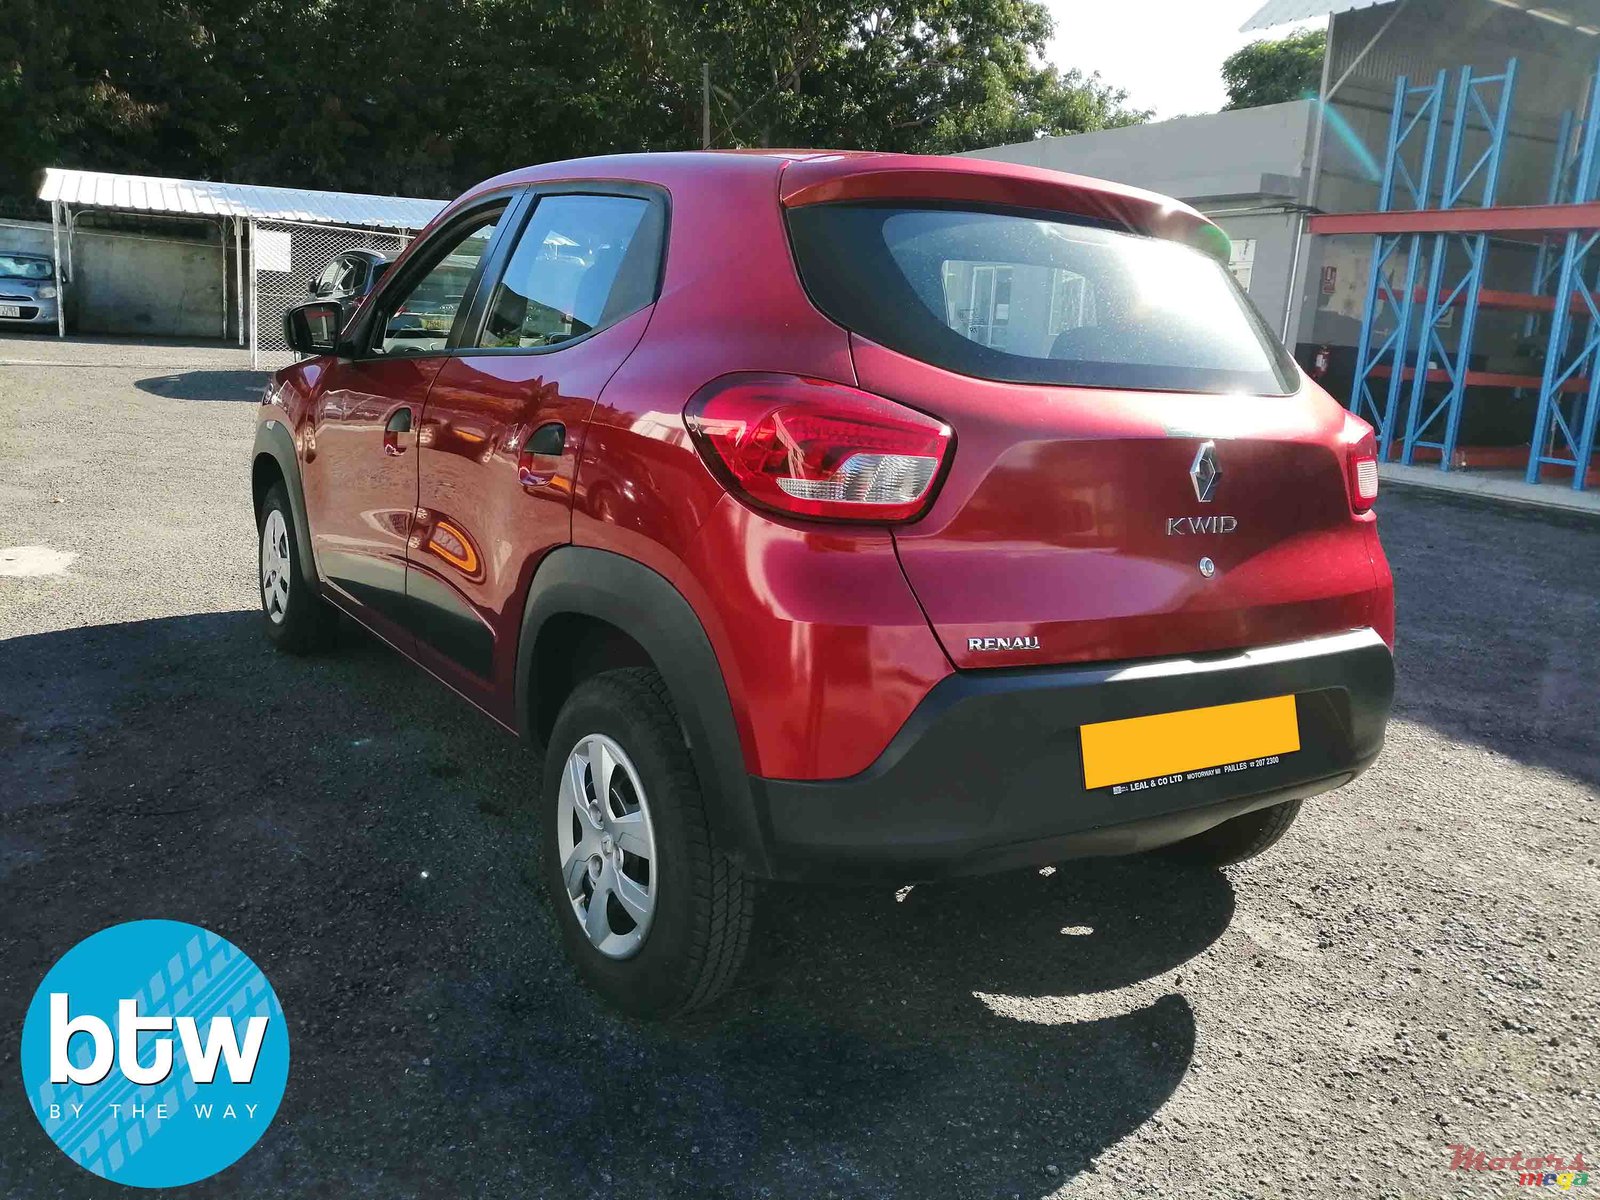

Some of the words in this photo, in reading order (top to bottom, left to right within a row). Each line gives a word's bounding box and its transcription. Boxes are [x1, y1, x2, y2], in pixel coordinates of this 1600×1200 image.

[1166, 516, 1238, 535] KWID
[1130, 781, 1149, 791] LEAL
[1150, 779, 1156, 788] &
[1157, 777, 1168, 786] CO
[1169, 774, 1183, 784] LTD
[1186, 769, 1215, 780] MOTORWAY
[1224, 762, 1247, 773] PAILLES
[1255, 758, 1265, 767] 207
[1266, 756, 1279, 765] 2300
